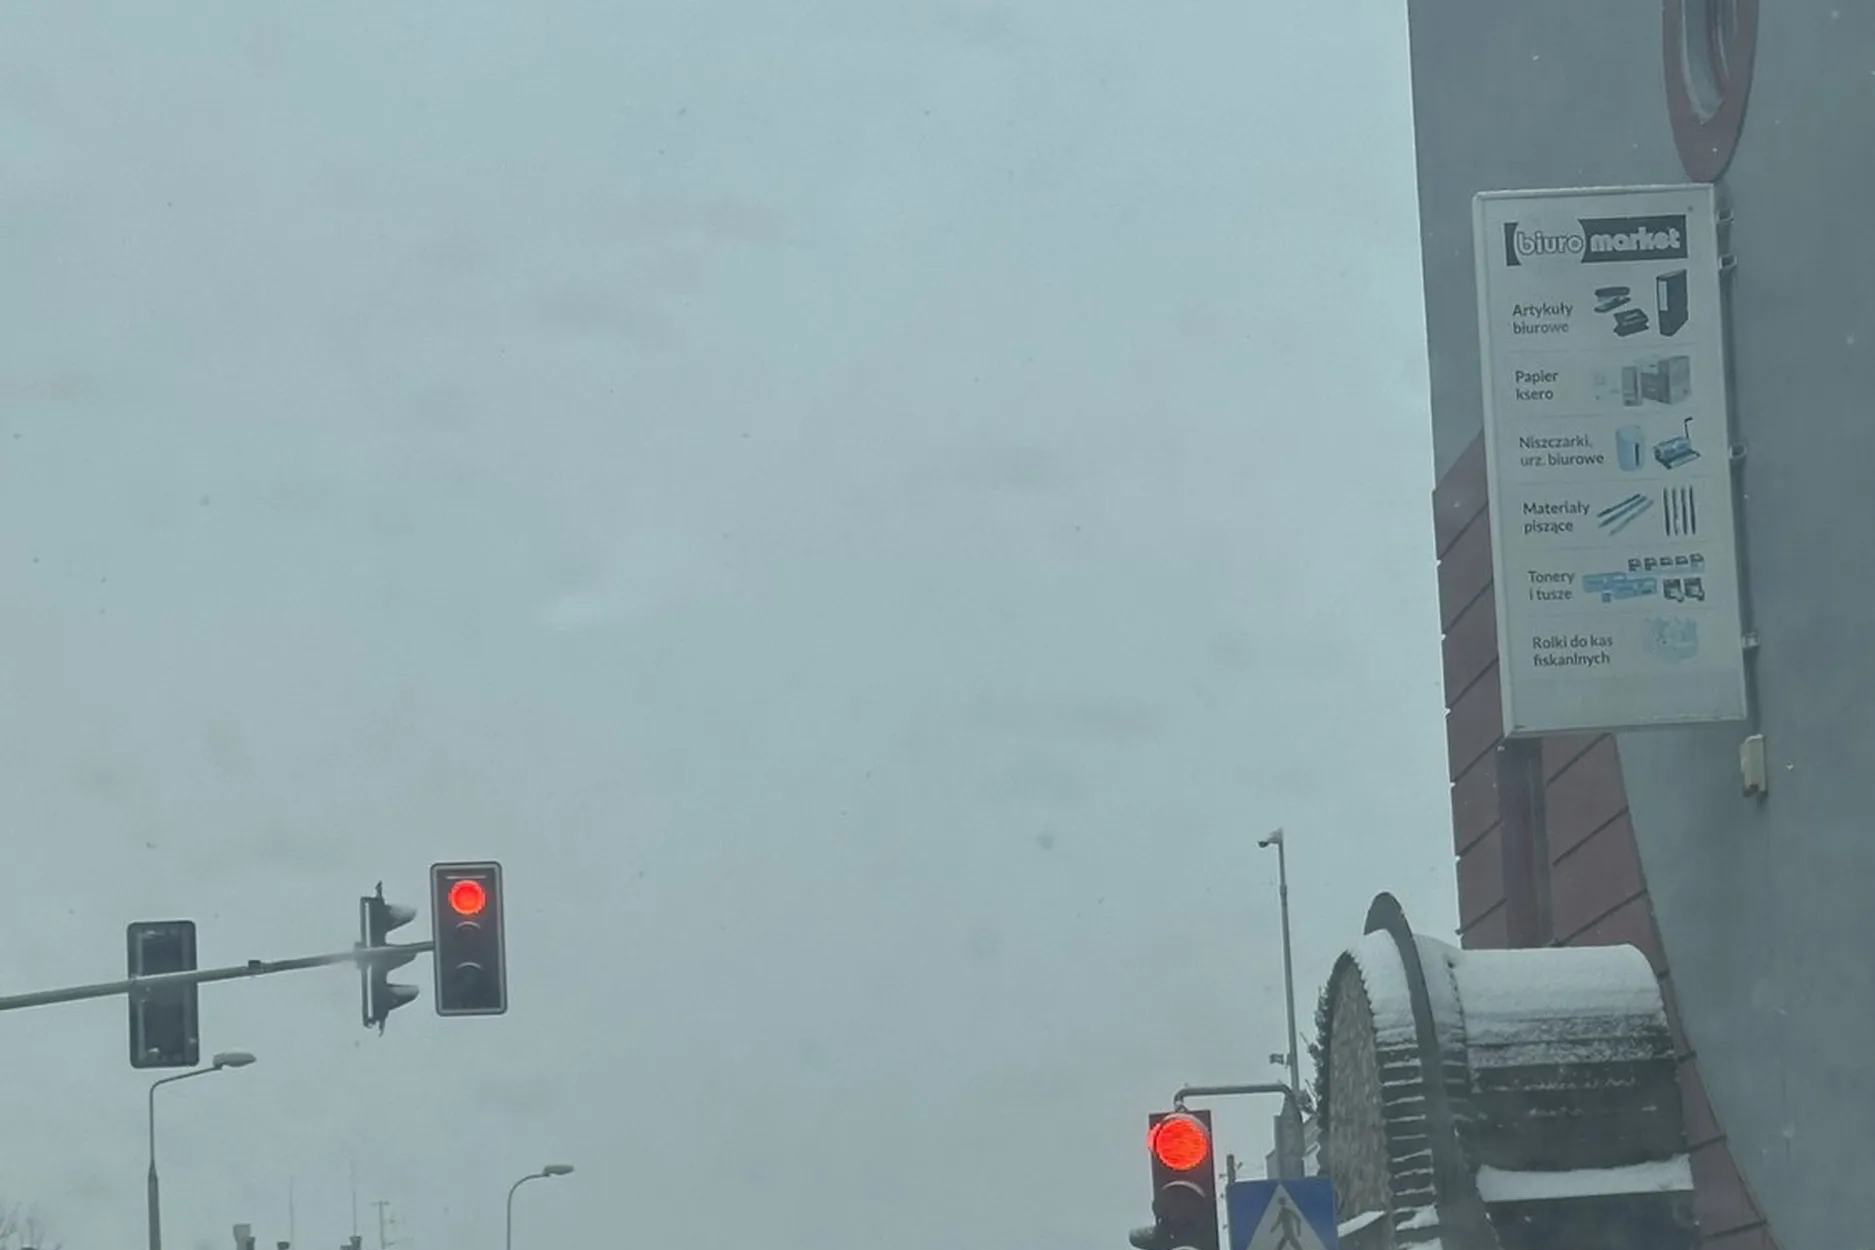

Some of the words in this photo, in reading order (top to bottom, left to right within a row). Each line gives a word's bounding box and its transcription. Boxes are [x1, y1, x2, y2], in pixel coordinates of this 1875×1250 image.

[1514, 230, 1585, 256] biuro
[1590, 226, 1682, 253] market
[1512, 302, 1574, 320] Artykuły
[1512, 321, 1570, 336] biurowe
[1515, 369, 1559, 385] Papier
[1515, 387, 1554, 402] ksero
[1520, 454, 1545, 468] urz.
[1548, 451, 1605, 466] biurowe
[1522, 501, 1591, 517] Materiały
[1523, 518, 1574, 535] piszące
[1528, 569, 1575, 586] Tonery
[1537, 588, 1573, 601] tusze
[1532, 636, 1568, 650] Rolki
[1570, 635, 1588, 649] do
[1590, 634, 1614, 647] kas
